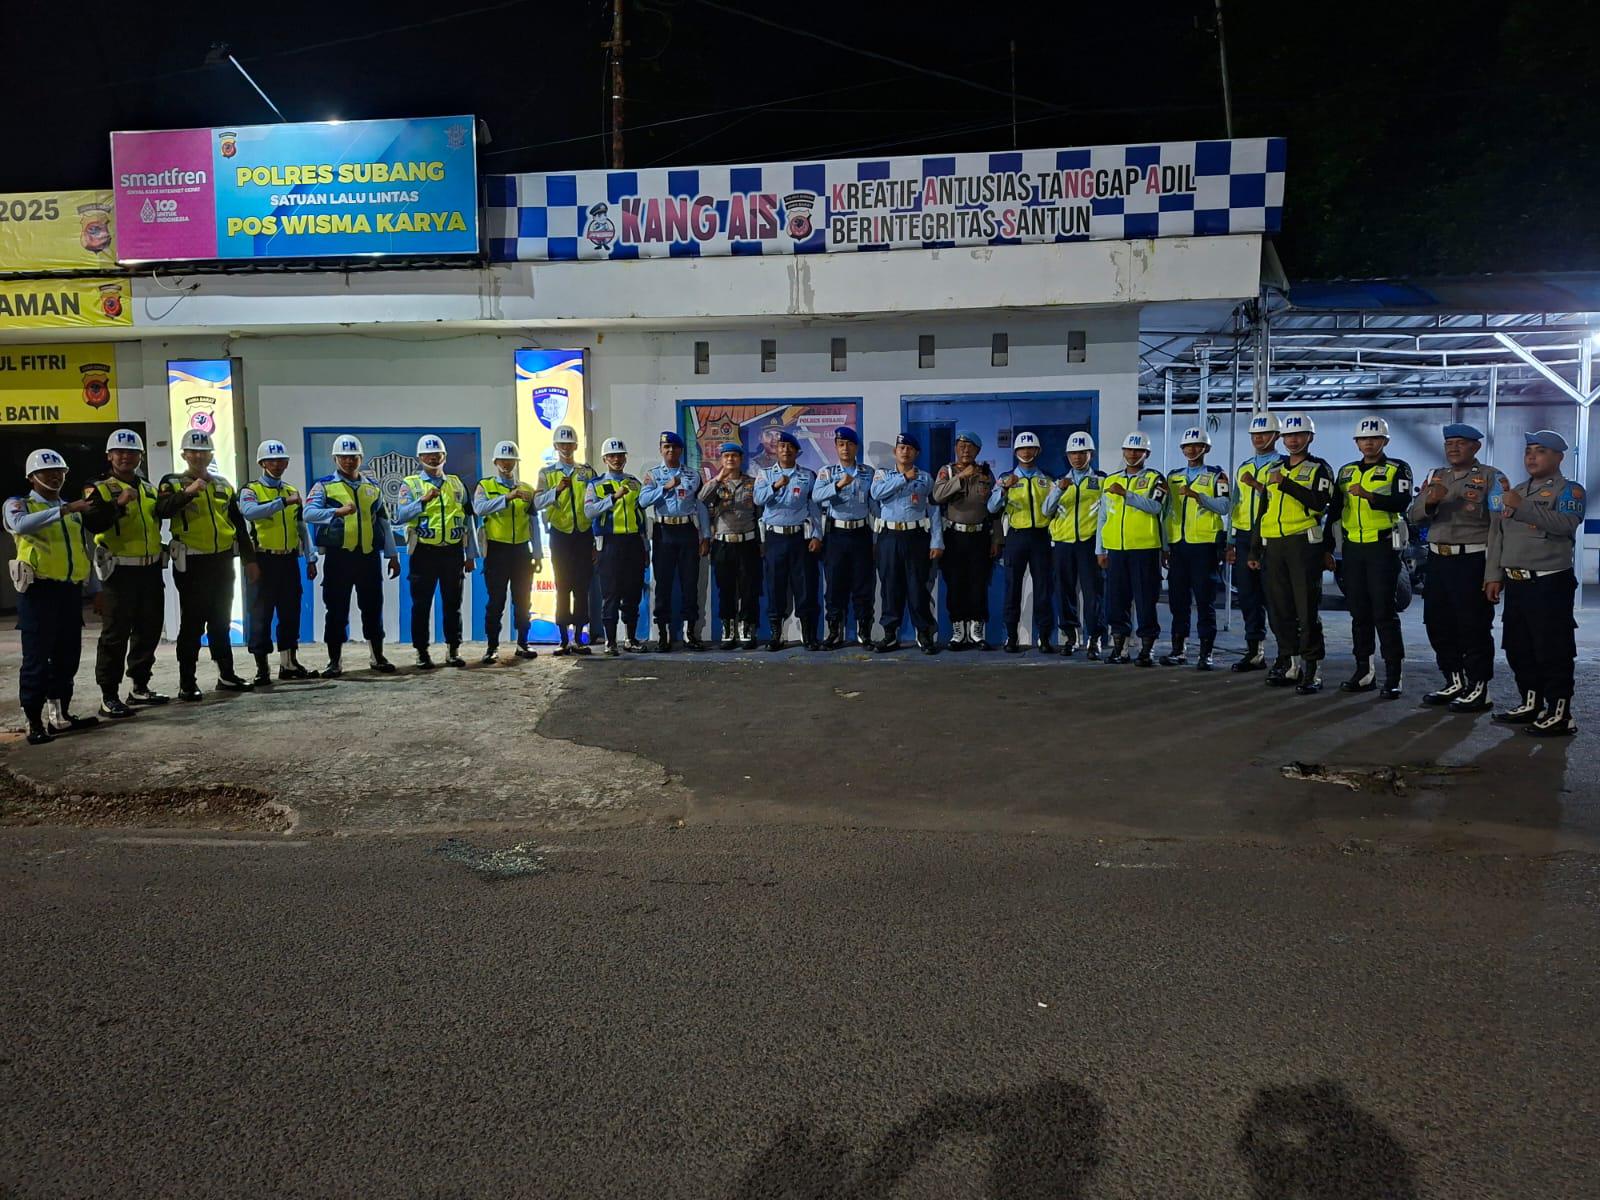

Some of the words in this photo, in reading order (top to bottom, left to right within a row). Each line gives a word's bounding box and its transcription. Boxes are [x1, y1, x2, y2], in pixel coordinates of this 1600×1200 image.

[120, 168, 206, 187] smartfren
[236, 164, 333, 187] POLRES
[338, 161, 444, 184] SUBANG
[832, 179, 918, 211] KREATIF
[924, 173, 1031, 206] ANTUSIAS
[1037, 168, 1139, 200] TANGGAP
[1145, 164, 1197, 194] ADIL
[270, 193, 327, 206] SATUAN
[330, 192, 366, 204] LALU
[369, 191, 419, 203] LINTAS
[0, 199, 60, 222] 2025
[621, 196, 717, 243] KANG
[727, 193, 778, 240] AIS
[227, 216, 277, 237] POS
[280, 214, 372, 236] WISMA
[376, 211, 467, 232] KARYA
[832, 209, 996, 244] BERINTEGRITAS
[1002, 205, 1090, 237] SANTUN
[0, 292, 80, 317] AMAN
[21, 355, 66, 370] FITRI
[6, 406, 59, 421] BATIN
[1286, 418, 1302, 428] PM
[1361, 421, 1379, 431] PM
[118, 433, 136, 444] PM
[192, 434, 208, 445] PM
[560, 430, 572, 438] PM
[1020, 435, 1034, 443] PM
[1185, 430, 1199, 439] PM
[342, 442, 356, 450] PM
[426, 440, 439, 448] PM
[610, 441, 624, 450] PM
[1072, 438, 1085, 446] PM
[1128, 436, 1142, 445] PM
[268, 444, 284, 454] PM
[501, 446, 514, 454] PM
[42, 453, 61, 464] PM
